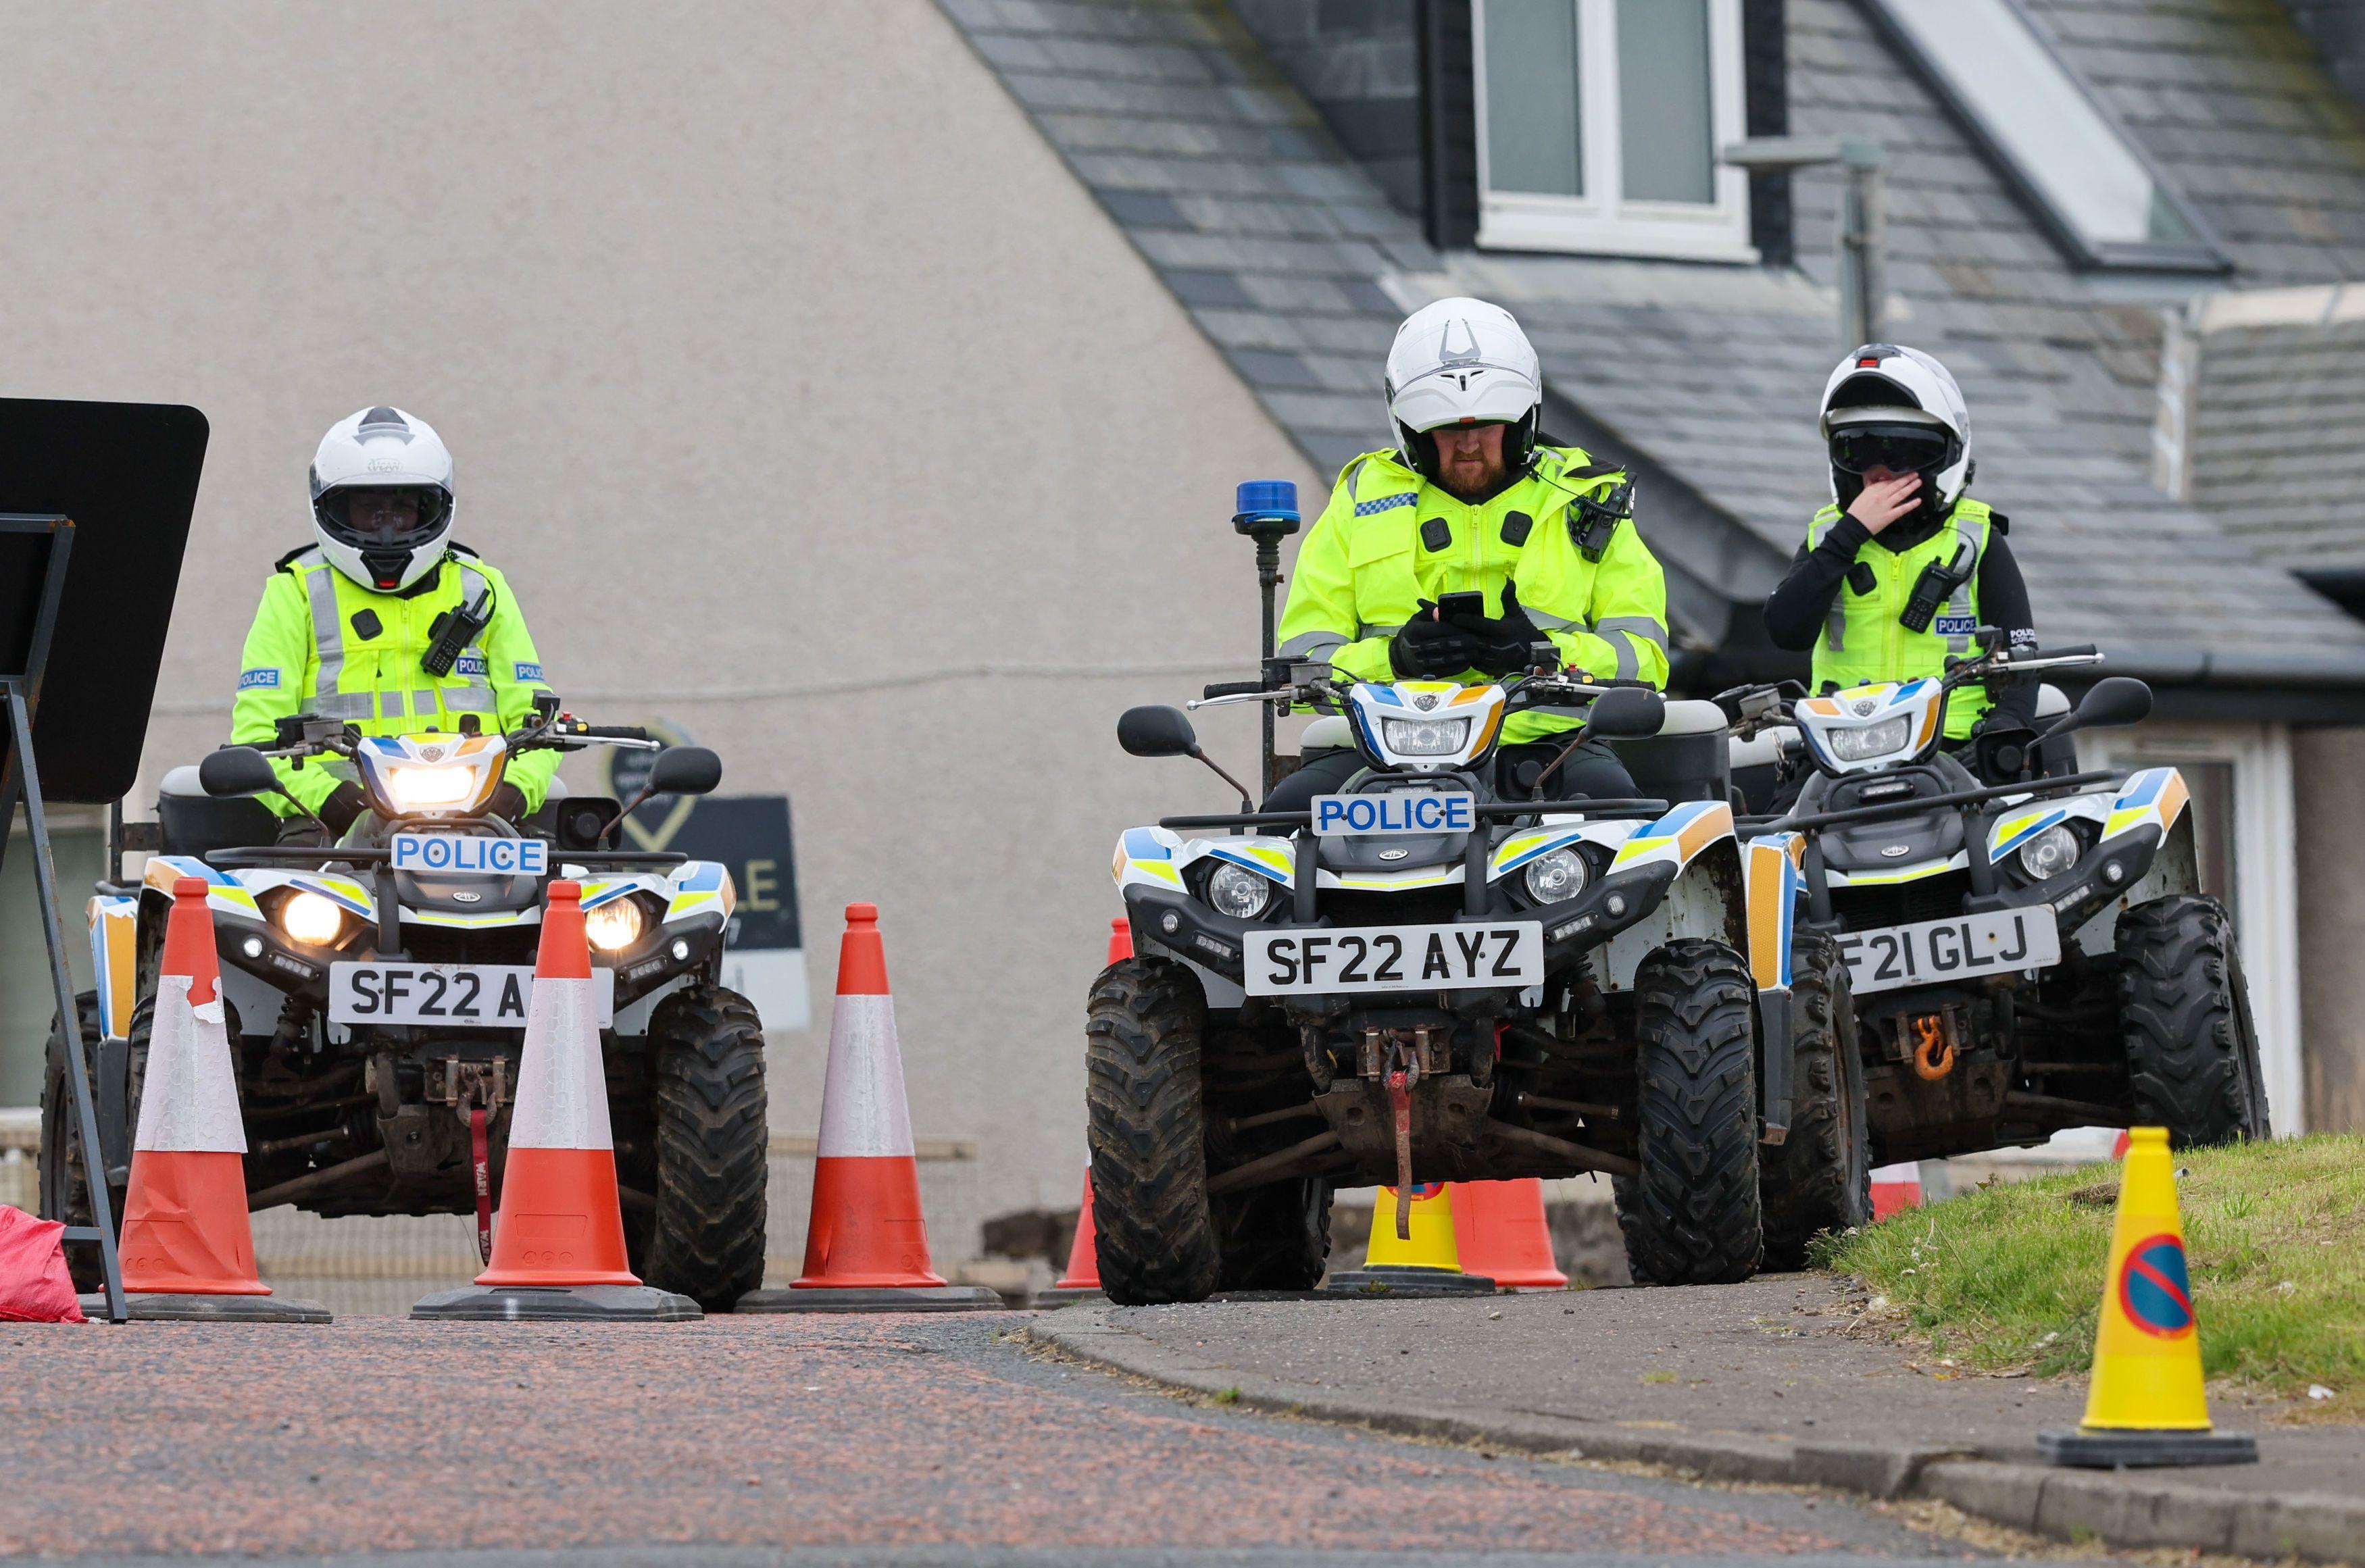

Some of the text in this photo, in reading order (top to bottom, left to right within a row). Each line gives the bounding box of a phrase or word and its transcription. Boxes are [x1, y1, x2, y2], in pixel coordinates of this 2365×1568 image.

[1939, 619, 1974, 632] POLICE
[1320, 798, 1470, 831] POLICE
[397, 838, 542, 871] POLICE
[1267, 930, 1521, 985] SF22 AYZ
[1837, 915, 2027, 982] F21 GLJ
[351, 969, 480, 1017] SF22
[476, 1161, 488, 1196] WARN
